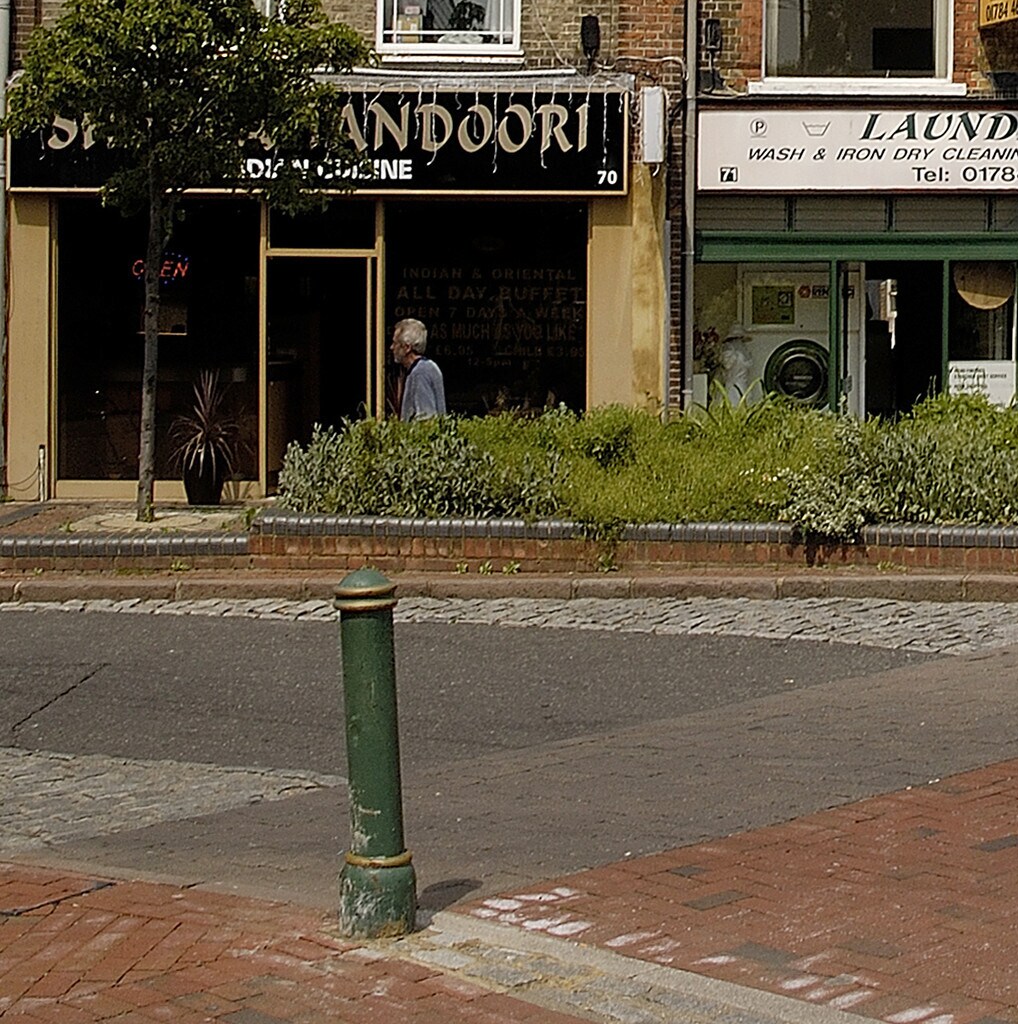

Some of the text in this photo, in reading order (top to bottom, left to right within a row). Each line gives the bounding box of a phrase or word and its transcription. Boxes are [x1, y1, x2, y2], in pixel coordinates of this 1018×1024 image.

[308, 102, 590, 153] ANDOORI
[748, 147, 806, 161] WASH
[812, 147, 827, 161] &
[836, 147, 886, 161] IRON
[892, 147, 935, 161] DRY
[597, 169, 618, 185] 70
[721, 167, 738, 182] 71
[911, 167, 950, 182] Tel:
[130, 259, 190, 278] OEN
[491, 268, 577, 281] ORIENTAL
[396, 286, 437, 300] ALL
[447, 286, 488, 300] DAY
[394, 307, 440, 318] OPEN
